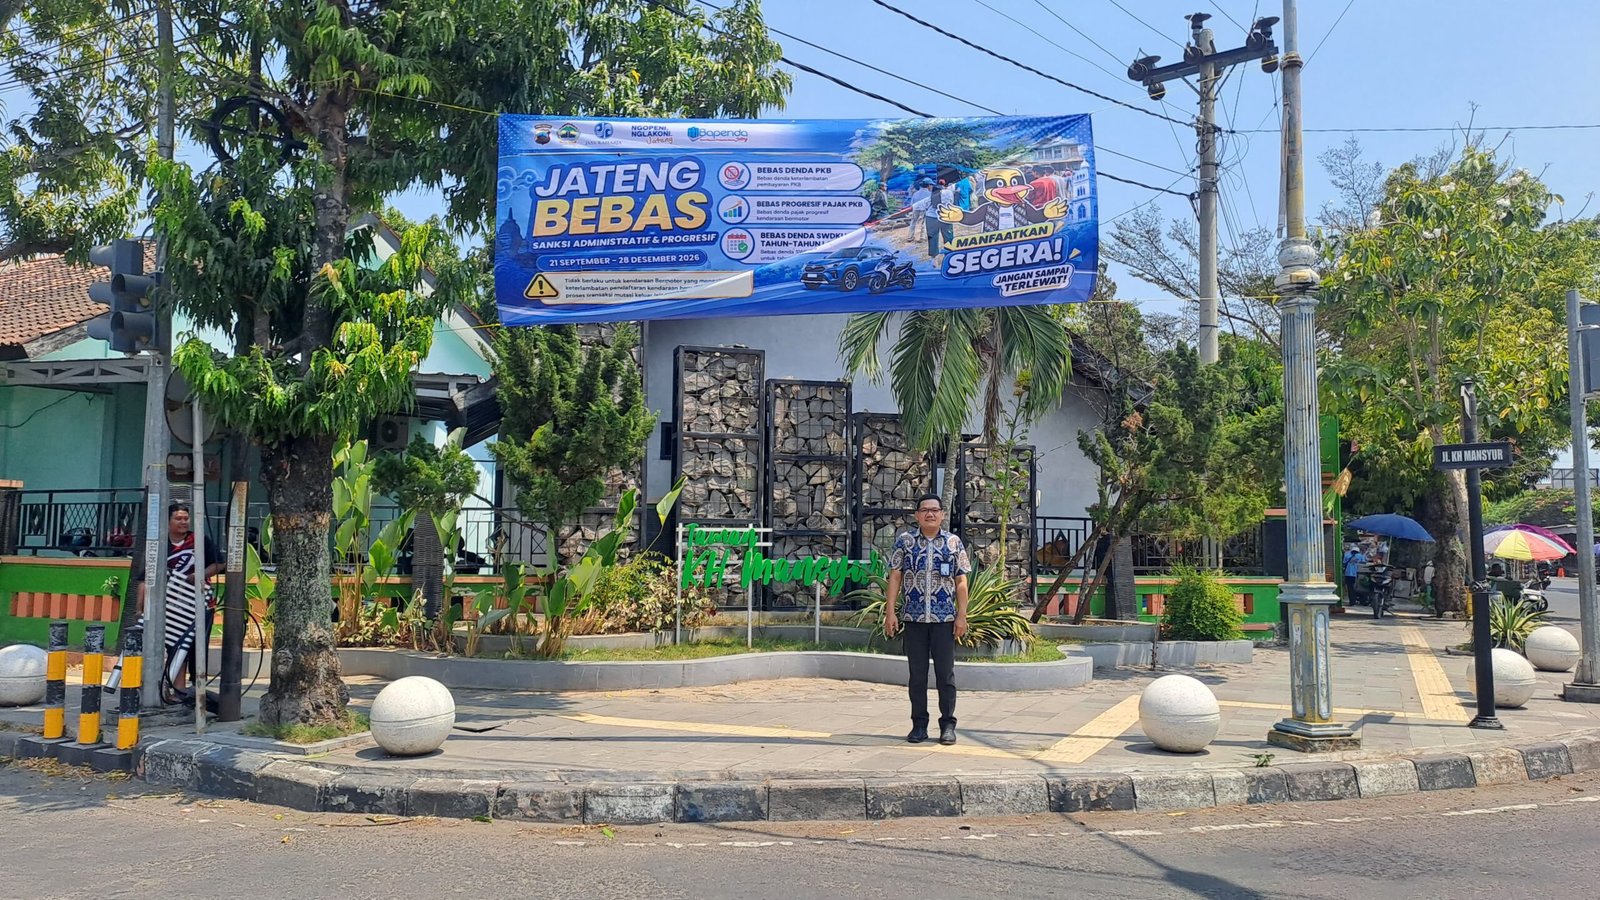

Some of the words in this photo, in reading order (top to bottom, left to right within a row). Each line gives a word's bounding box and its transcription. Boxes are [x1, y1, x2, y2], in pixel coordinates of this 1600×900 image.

[699, 128, 748, 138] Bapenda
[535, 160, 700, 197] JATENG
[532, 191, 708, 237] BEBAS
[532, 240, 571, 249] SANKSI
[573, 236, 651, 248] ADMINISTRATIF
[662, 233, 717, 244] PROGRESIF
[956, 226, 1048, 248] MANFAATKAN
[560, 257, 610, 266] SEPTEMBER
[631, 255, 676, 263] DESEMBER
[947, 238, 1062, 274] SEGERA!
[996, 272, 1033, 284] JANGAN
[1035, 267, 1069, 278] SAMPAI
[1004, 276, 1067, 292] TERLEWAT!
[1451, 451, 1462, 462] KH
[1464, 449, 1503, 461] MANSYUR
[685, 523, 758, 548] Taman
[681, 549, 730, 590] KH
